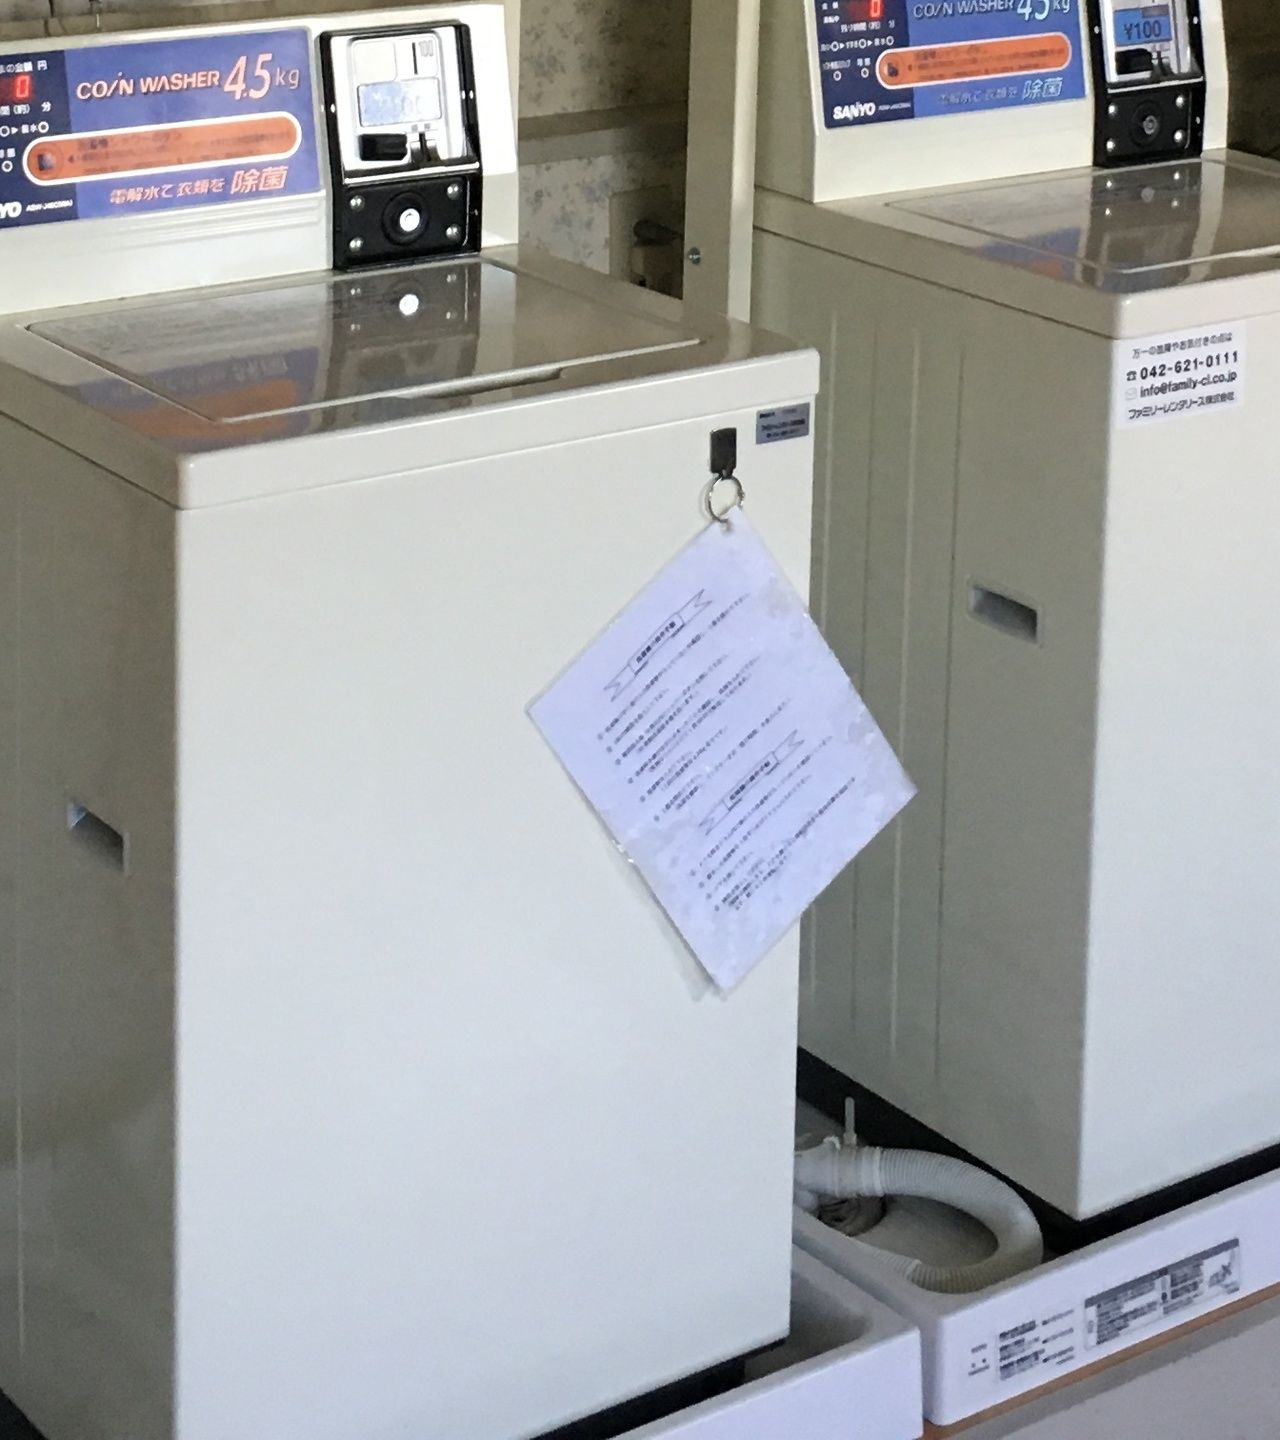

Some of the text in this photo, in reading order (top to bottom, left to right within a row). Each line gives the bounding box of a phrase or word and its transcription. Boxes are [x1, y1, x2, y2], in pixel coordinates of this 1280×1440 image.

[1123, 20, 1162, 40] ¥100
[16, 74, 31, 98] 0
[76, 71, 135, 100] COIN
[140, 69, 220, 96] WASHER
[833, 101, 876, 120] SANYO
[1140, 350, 1238, 380] 042-621-0111
